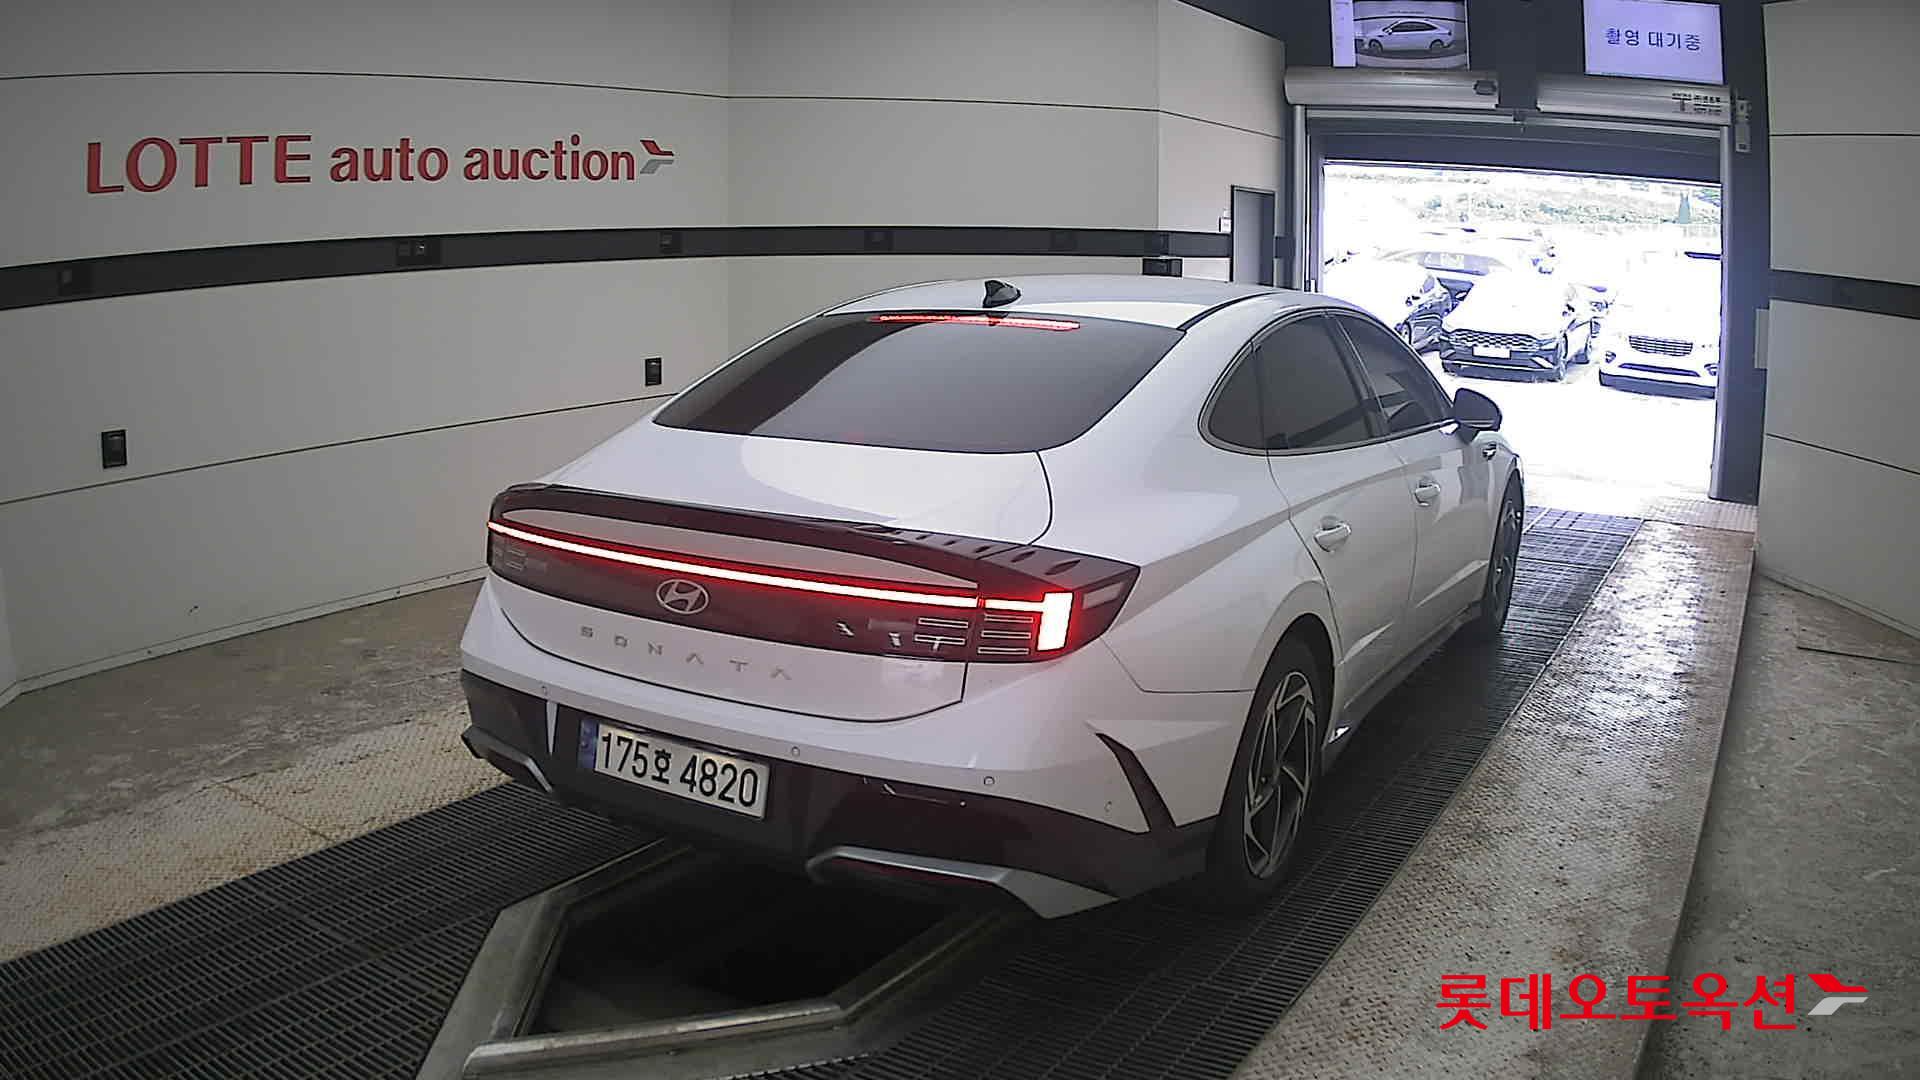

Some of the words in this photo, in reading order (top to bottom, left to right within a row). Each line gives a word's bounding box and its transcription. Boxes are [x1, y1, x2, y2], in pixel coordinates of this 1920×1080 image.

[1647, 31, 1701, 51] 대기중
[86, 134, 311, 193] LOTTE
[329, 138, 449, 181] auto
[463, 134, 636, 181] auction
[579, 625, 793, 681] SONATA
[601, 731, 672, 785] 175호
[679, 754, 759, 808] 4820
